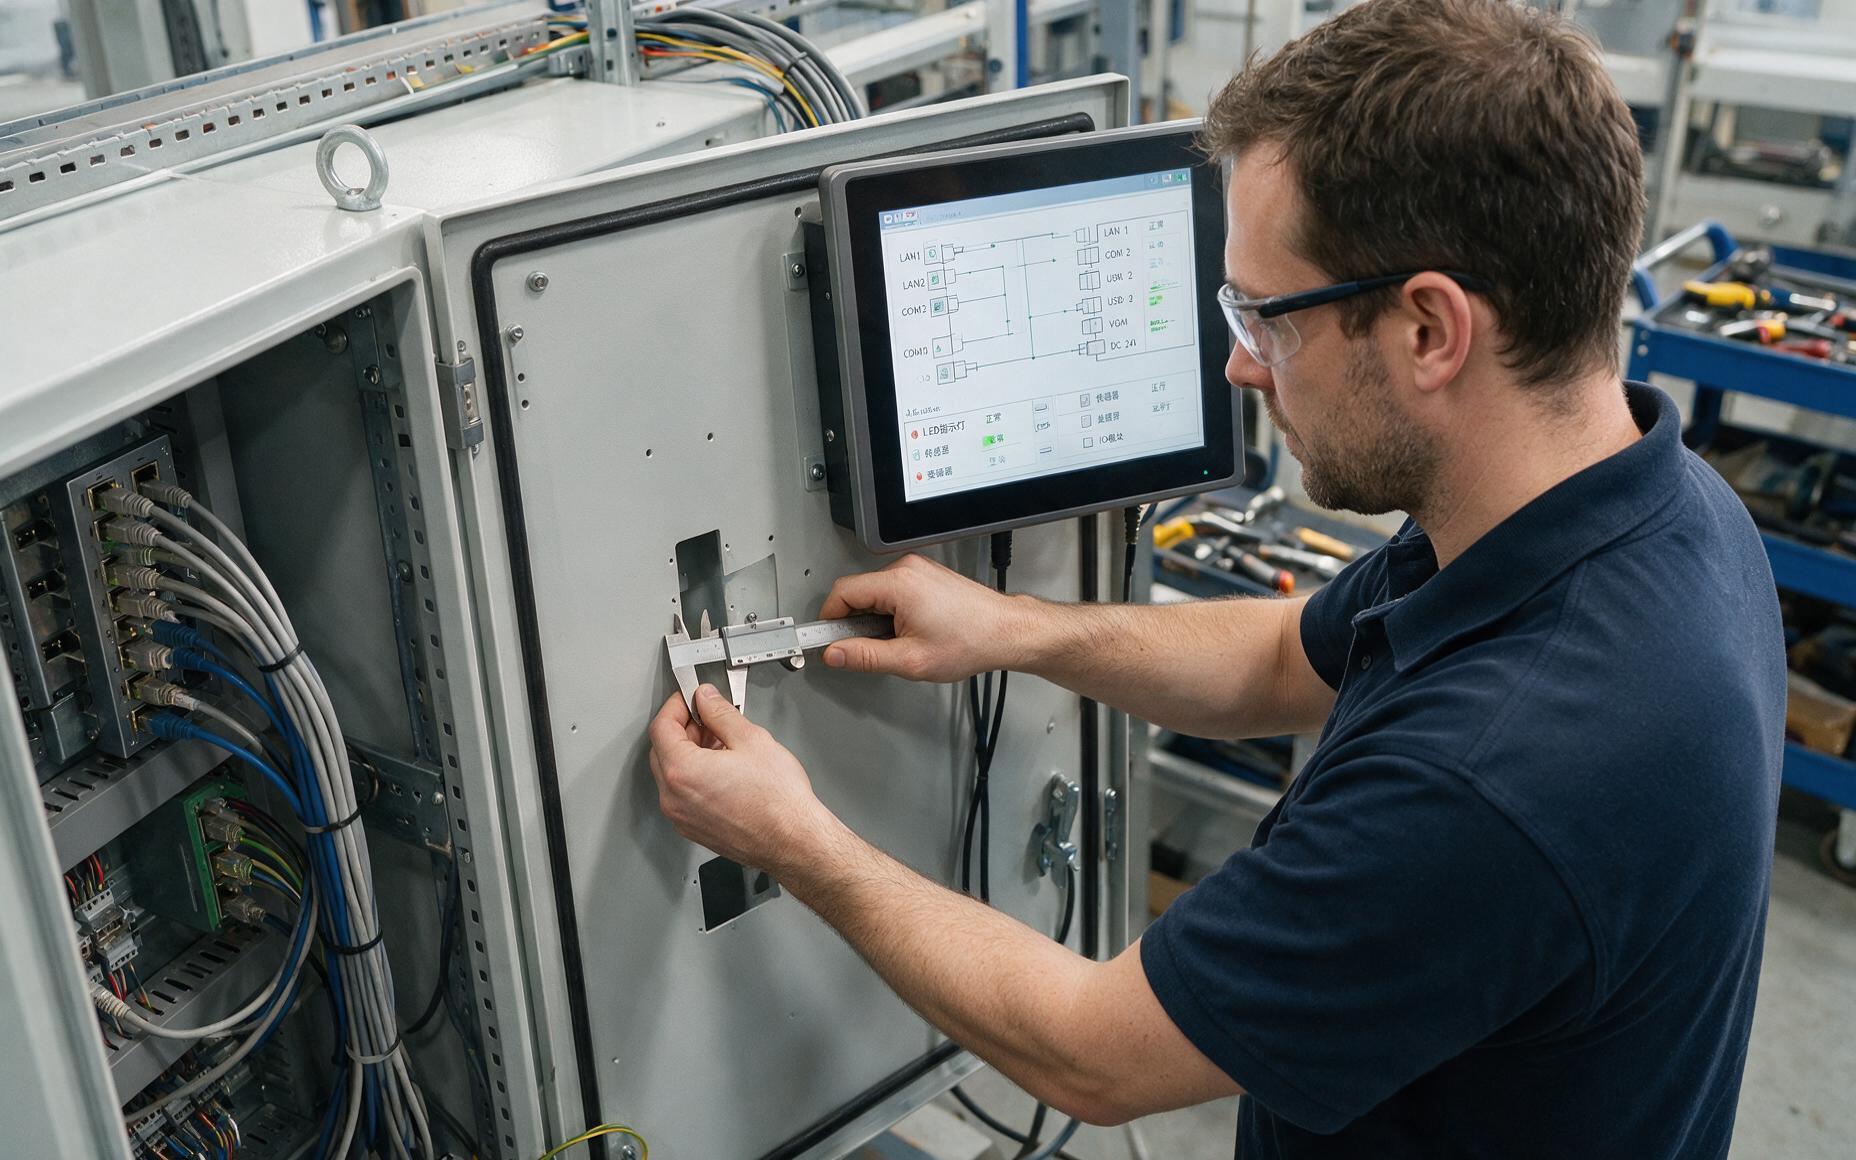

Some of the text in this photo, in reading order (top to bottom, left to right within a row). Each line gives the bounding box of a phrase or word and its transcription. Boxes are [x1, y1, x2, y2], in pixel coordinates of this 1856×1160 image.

[1104, 225, 1128, 237] LAN 1
[899, 251, 920, 263] LAN1
[1105, 248, 1131, 259] COM 2
[1127, 271, 1133, 280] 2
[903, 278, 925, 290] LAN2
